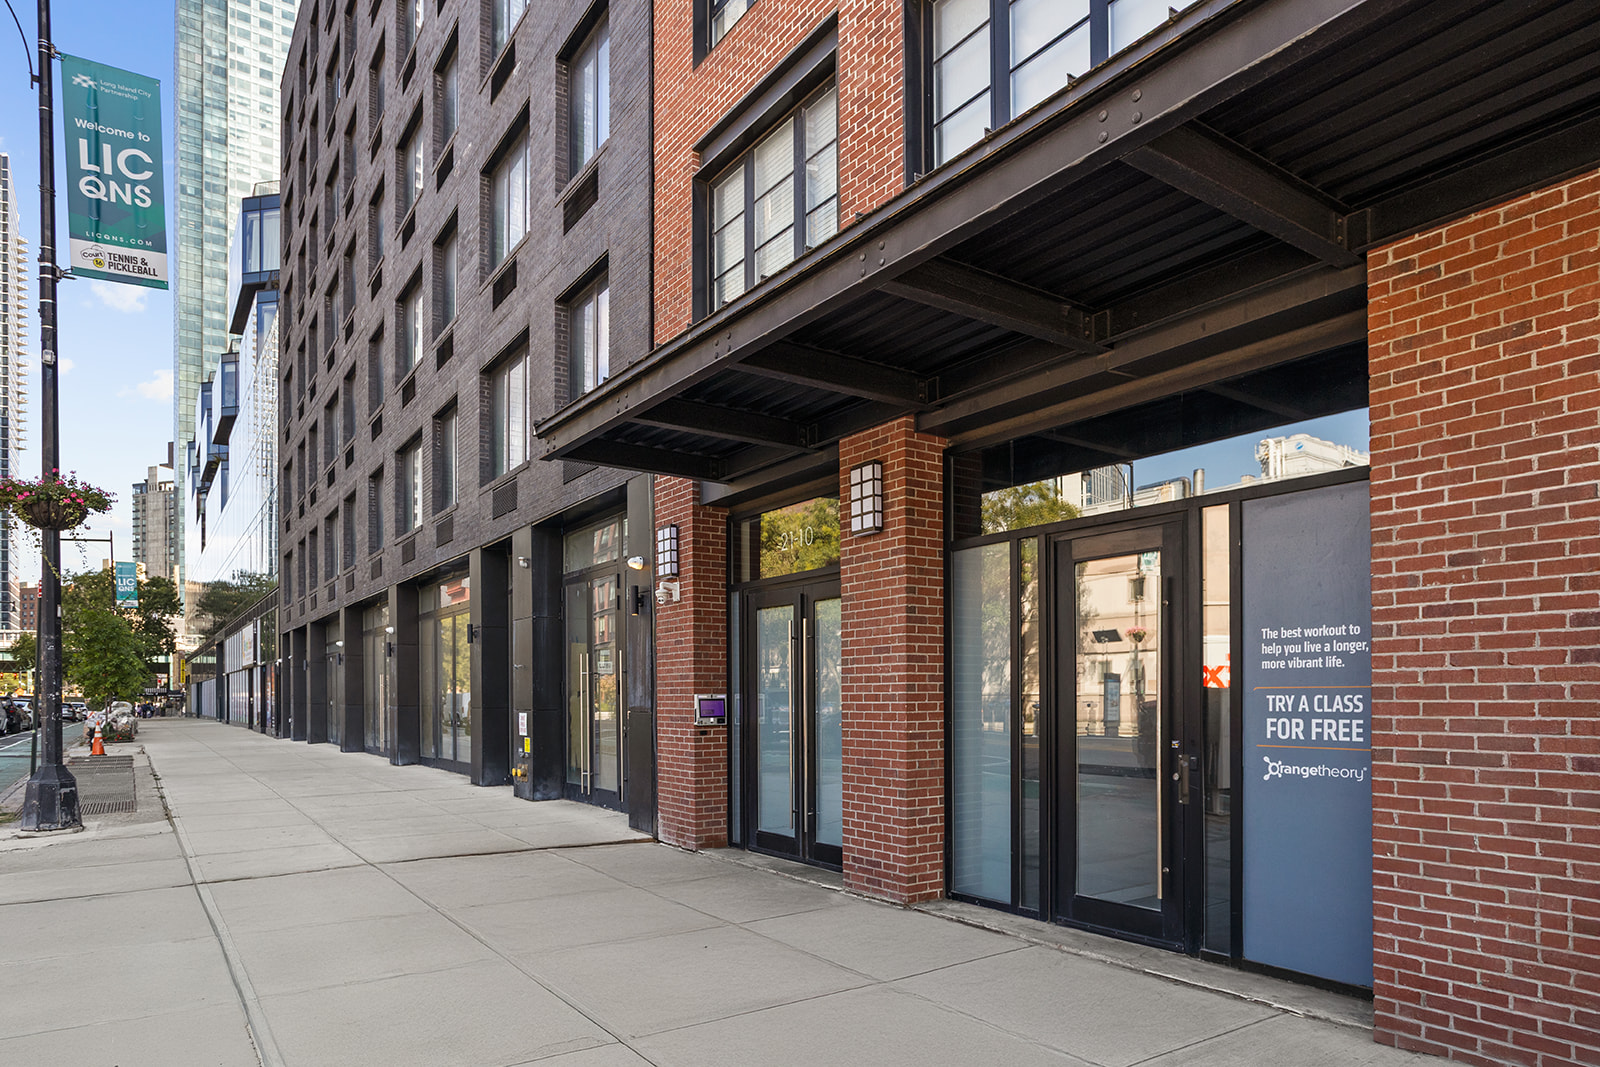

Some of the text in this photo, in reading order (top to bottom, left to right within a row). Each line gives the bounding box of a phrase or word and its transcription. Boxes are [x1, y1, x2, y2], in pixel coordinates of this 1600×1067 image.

[100, 80, 152, 98] Long Island City
[100, 86, 138, 100] Partnership
[74, 118, 150, 142] Welcome to
[78, 138, 153, 181] LIC
[79, 175, 152, 208] QNS
[86, 231, 152, 246] LICQNS.COM
[107, 252, 148, 266] TENNIS &
[108, 262, 158, 276] PICKLEBALL
[781, 526, 813, 551] 21-10
[118, 578, 135, 586] LIC
[1262, 624, 1361, 639] The best workout to
[1262, 640, 1369, 656] help you live a longer,
[1262, 656, 1345, 669] more vibrant life.
[1266, 695, 1364, 713] TRY A CLASS
[1266, 718, 1364, 742] FOR FREE
